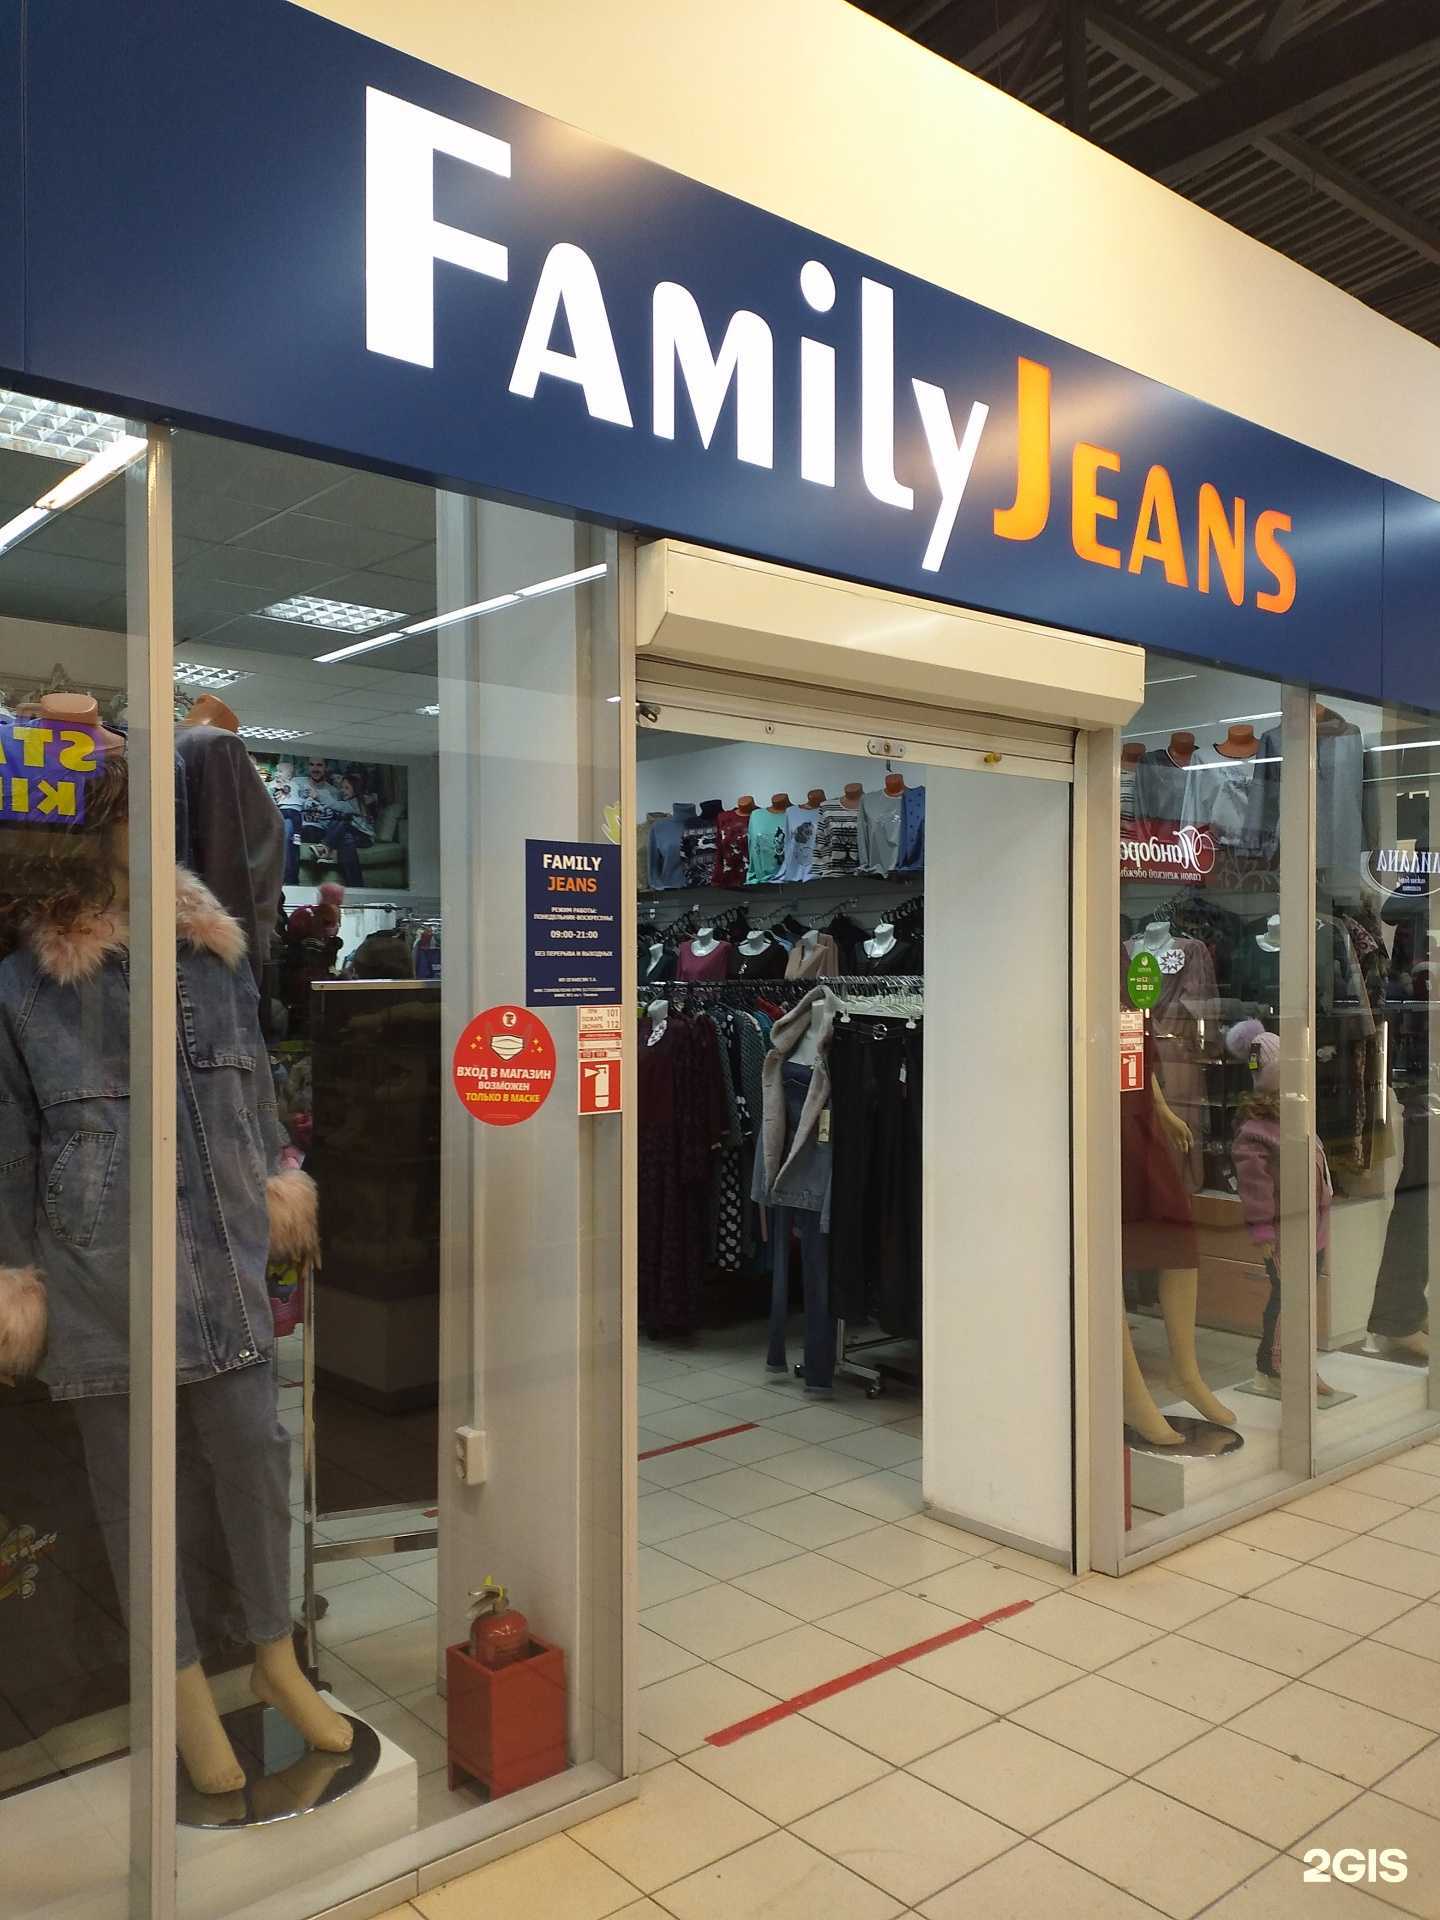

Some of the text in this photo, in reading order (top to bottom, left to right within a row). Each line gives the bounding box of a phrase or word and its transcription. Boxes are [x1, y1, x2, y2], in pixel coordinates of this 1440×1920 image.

[993, 354, 1297, 614] JEANS
[543, 854, 602, 871] FAMILY
[547, 876, 597, 893] JEANS
[550, 930, 598, 939] 09:00-21:00
[607, 1009, 619, 1017] 101
[607, 1020, 619, 1029] 112
[456, 1066, 551, 1080] ВХОД В МАГАЗИН
[478, 1081, 530, 1091] ВОЗМОЖЕН
[465, 1092, 541, 1103] ТОЛЬКО В МАСКЕ
